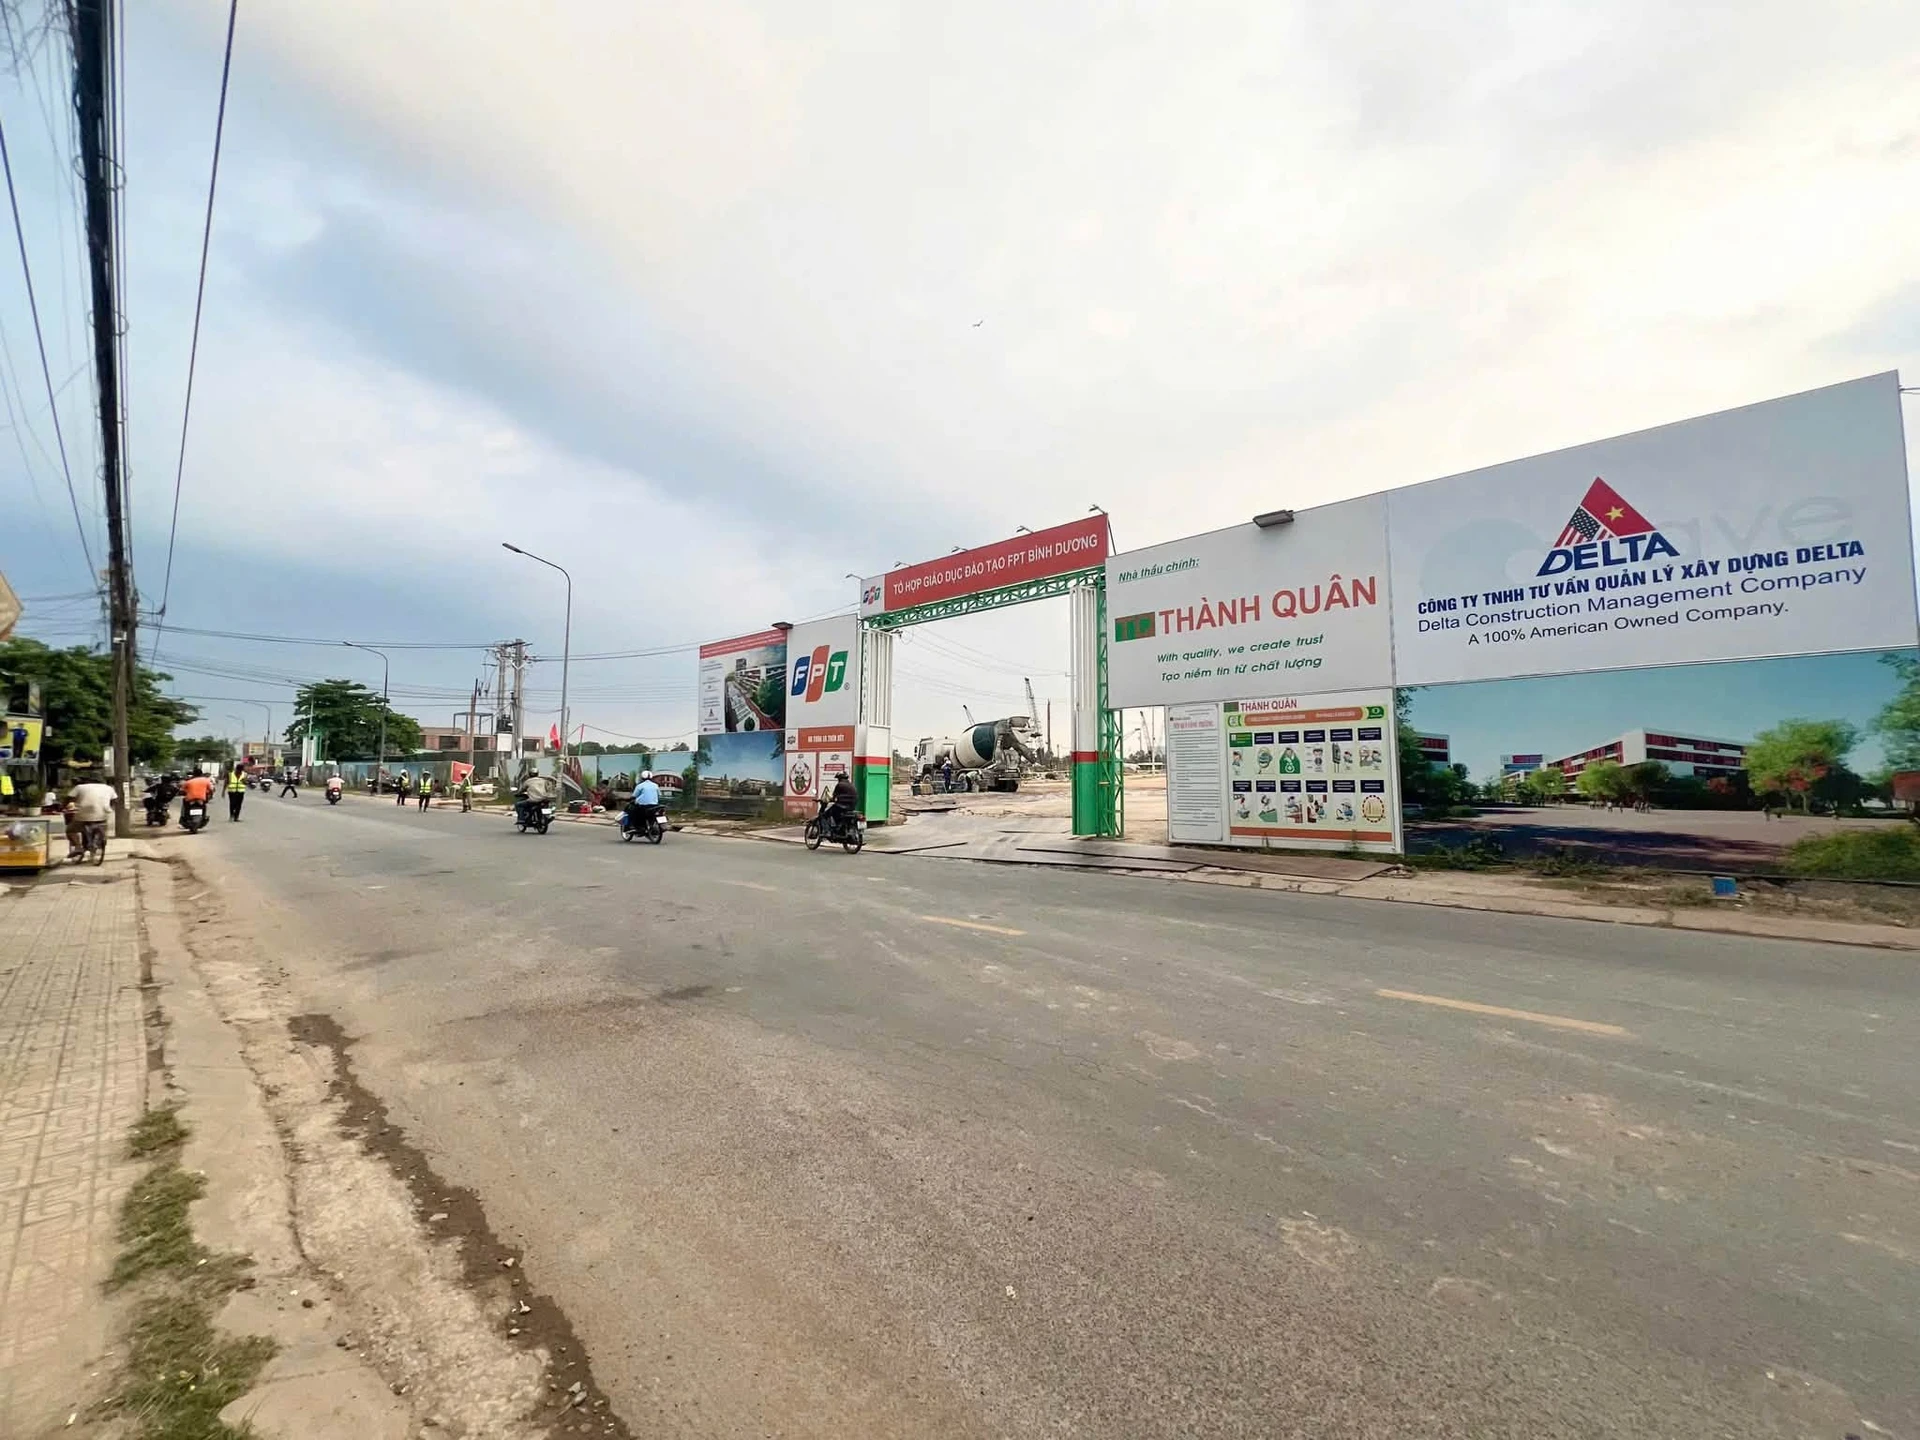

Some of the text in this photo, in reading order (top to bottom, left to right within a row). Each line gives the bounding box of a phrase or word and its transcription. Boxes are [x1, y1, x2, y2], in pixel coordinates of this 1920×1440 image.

[923, 571, 943, 587] GIÁO
[945, 568, 963, 584] DỤC
[986, 556, 1005, 574] TẠO
[1007, 551, 1026, 568] FPT
[1028, 544, 1052, 562] BÌNH
[1055, 533, 1098, 556] DƯƠNG
[1118, 569, 1138, 582] Nhà
[1536, 532, 1680, 577] DELTA
[1418, 540, 1865, 615] CÔNG TY TNHH TƯ VẤN QUẢN LÝ XÂY DỰNG DELTA
[1418, 567, 1867, 632] Delta Construction Management Company
[1158, 594, 1260, 634] THÀNH
[1271, 574, 1377, 619] QUÂN
[1468, 602, 1789, 645] A 100% American Owned Company.
[1157, 633, 1324, 663] With quality, we create trust
[1162, 672, 1180, 683] Tạo
[1216, 666, 1230, 676] tin
[1251, 659, 1280, 673] chất
[1285, 657, 1322, 670] lượng
